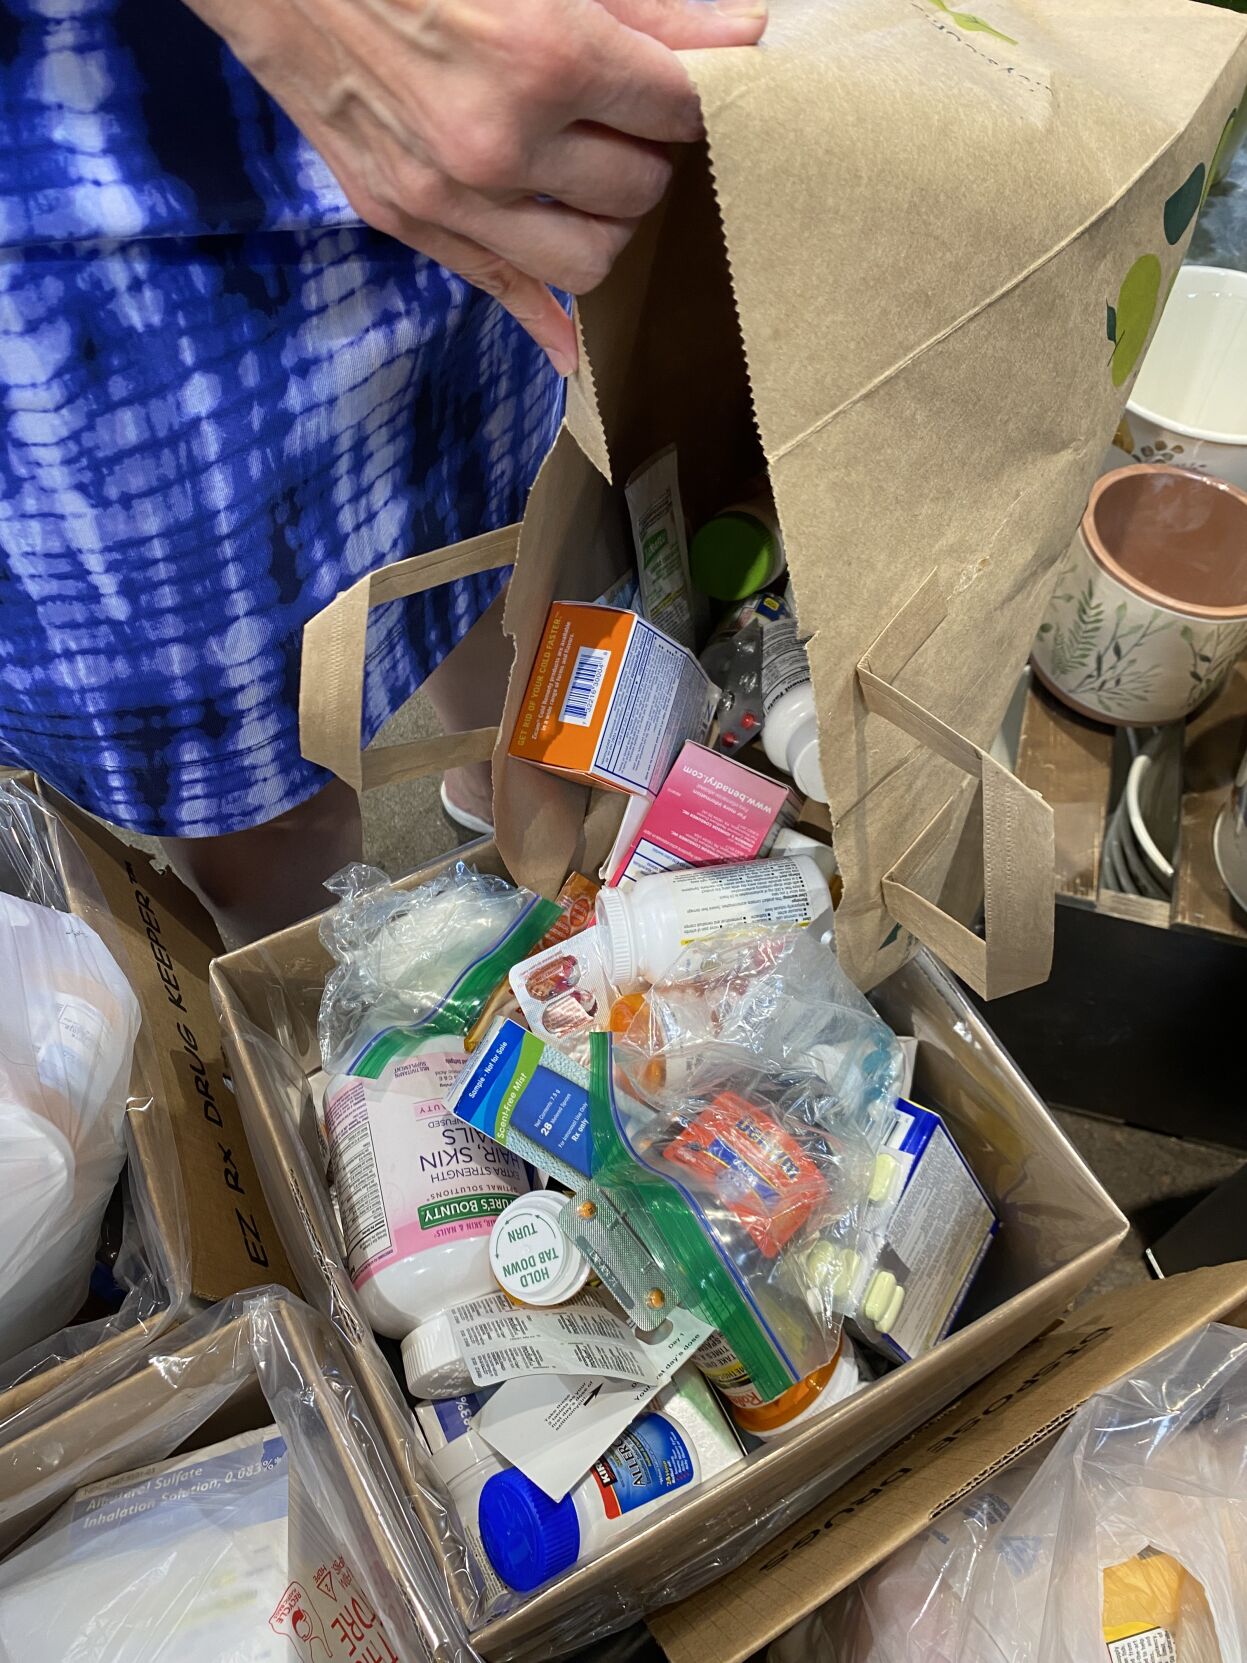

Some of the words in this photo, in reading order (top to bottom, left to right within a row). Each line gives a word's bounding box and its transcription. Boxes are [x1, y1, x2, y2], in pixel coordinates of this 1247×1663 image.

[539, 650, 551, 671] COLD
[531, 675, 544, 698] YOUR
[527, 700, 536, 711] OF
[522, 712, 533, 727] RID
[517, 727, 529, 746] GET
[681, 763, 773, 815] www.benadryl.com
[174, 1021, 225, 1130] DRUG
[468, 1075, 486, 1099] Sample
[483, 1062, 494, 1074] Not
[489, 1052, 500, 1064] for
[495, 1040, 508, 1055] Sale
[497, 1090, 517, 1136] Scent-Free
[512, 1071, 527, 1091] Mist
[440, 1120, 487, 1151] AILS
[539, 1120, 554, 1137] 28
[570, 1130, 580, 1141] Rx
[576, 1117, 590, 1133] only
[418, 1145, 473, 1171] SKIN
[429, 1166, 491, 1183] STRENGTH
[493, 1166, 519, 1177] EXTRA
[424, 1200, 479, 1221] BOUNTY
[482, 1216, 496, 1225] AIR,
[464, 1219, 482, 1230] SKIN
[507, 1222, 537, 1243] TURN
[236, 1207, 268, 1268] EZ
[502, 1255, 536, 1277] DOWN
[537, 1247, 558, 1263] TAB
[519, 1266, 549, 1288] HOLD
[664, 1350, 683, 1369] day's
[682, 1333, 700, 1350] dose
[667, 1336, 681, 1349] Day
[928, 1326, 1113, 1453] DISPOSE
[152, 1465, 204, 1489] Sulfate
[81, 1500, 157, 1528] Inhalation
[160, 1478, 221, 1503] Solution,
[758, 1467, 914, 1572] DRUGS
[275, 1589, 303, 1626] RECYCLE
